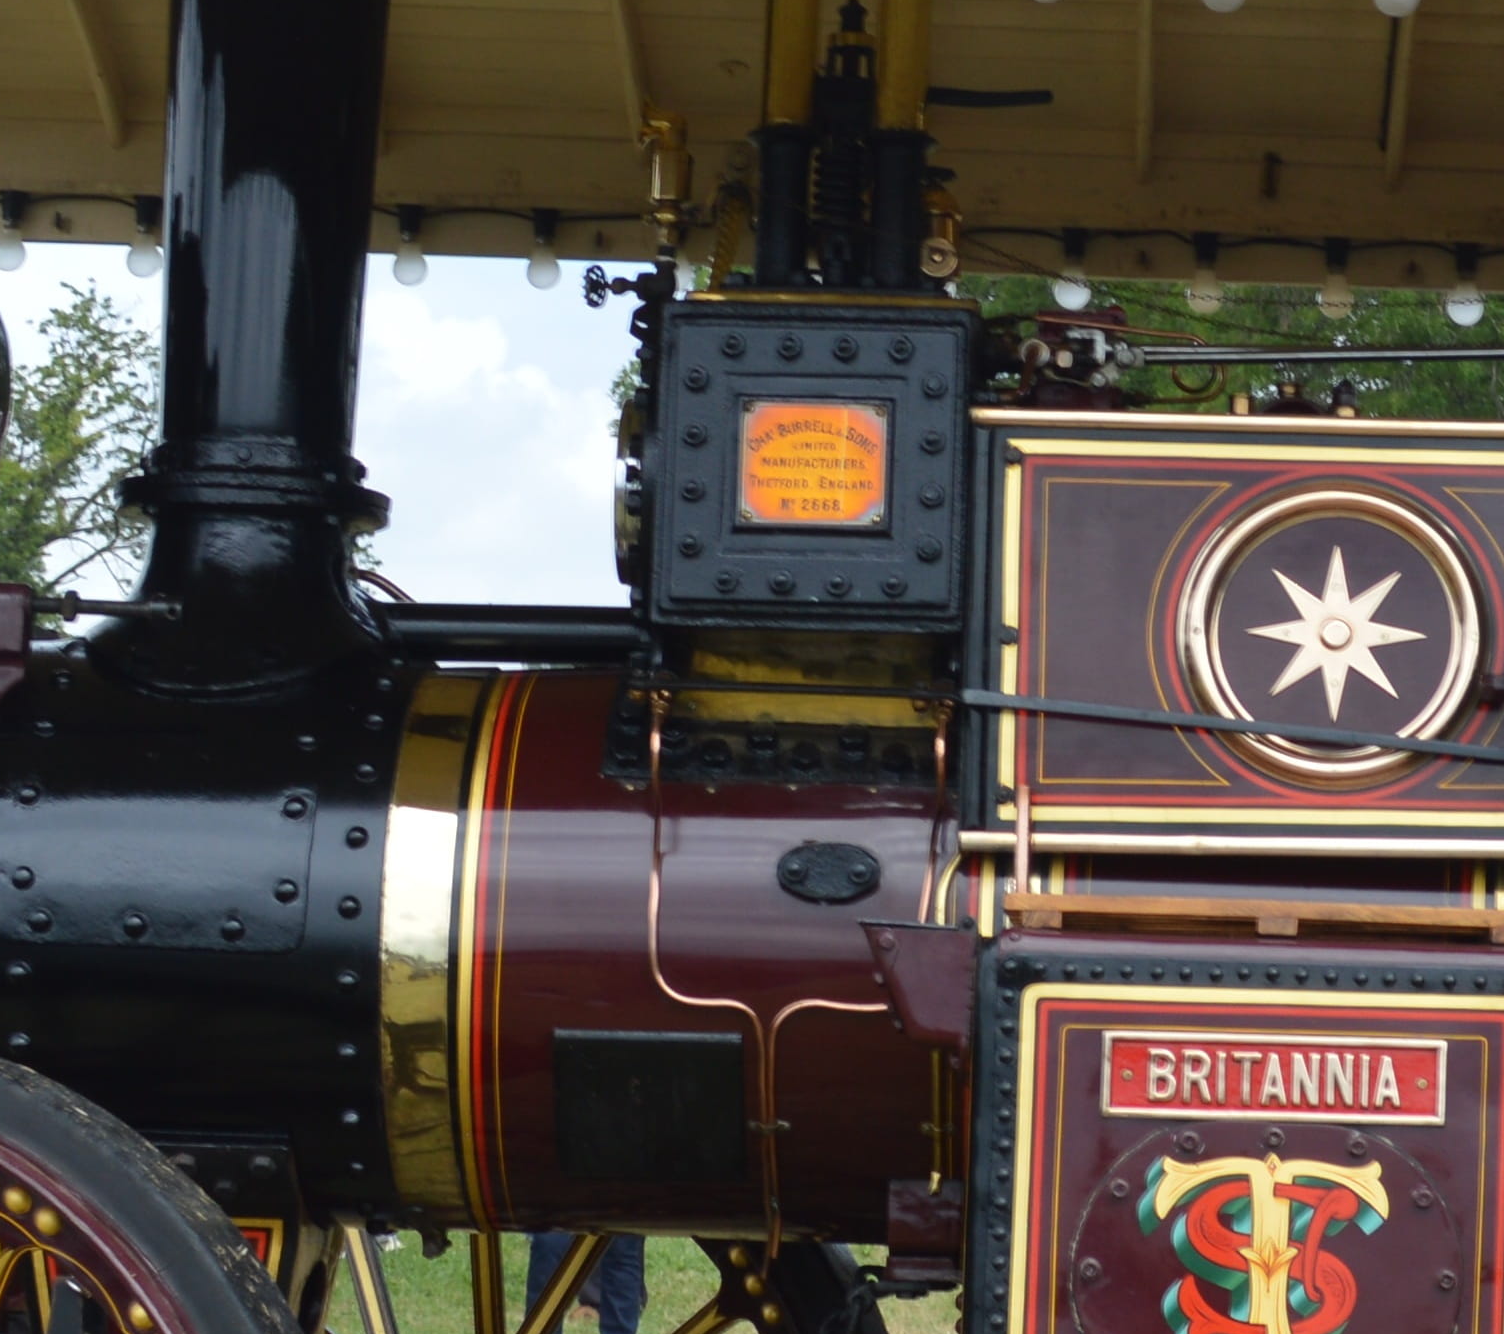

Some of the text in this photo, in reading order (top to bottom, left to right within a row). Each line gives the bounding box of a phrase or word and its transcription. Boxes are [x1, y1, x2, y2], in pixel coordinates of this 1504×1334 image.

[778, 420, 833, 437] BURRELL
[846, 426, 878, 455] SONS
[1145, 1046, 1402, 1111] BRITANNIA
